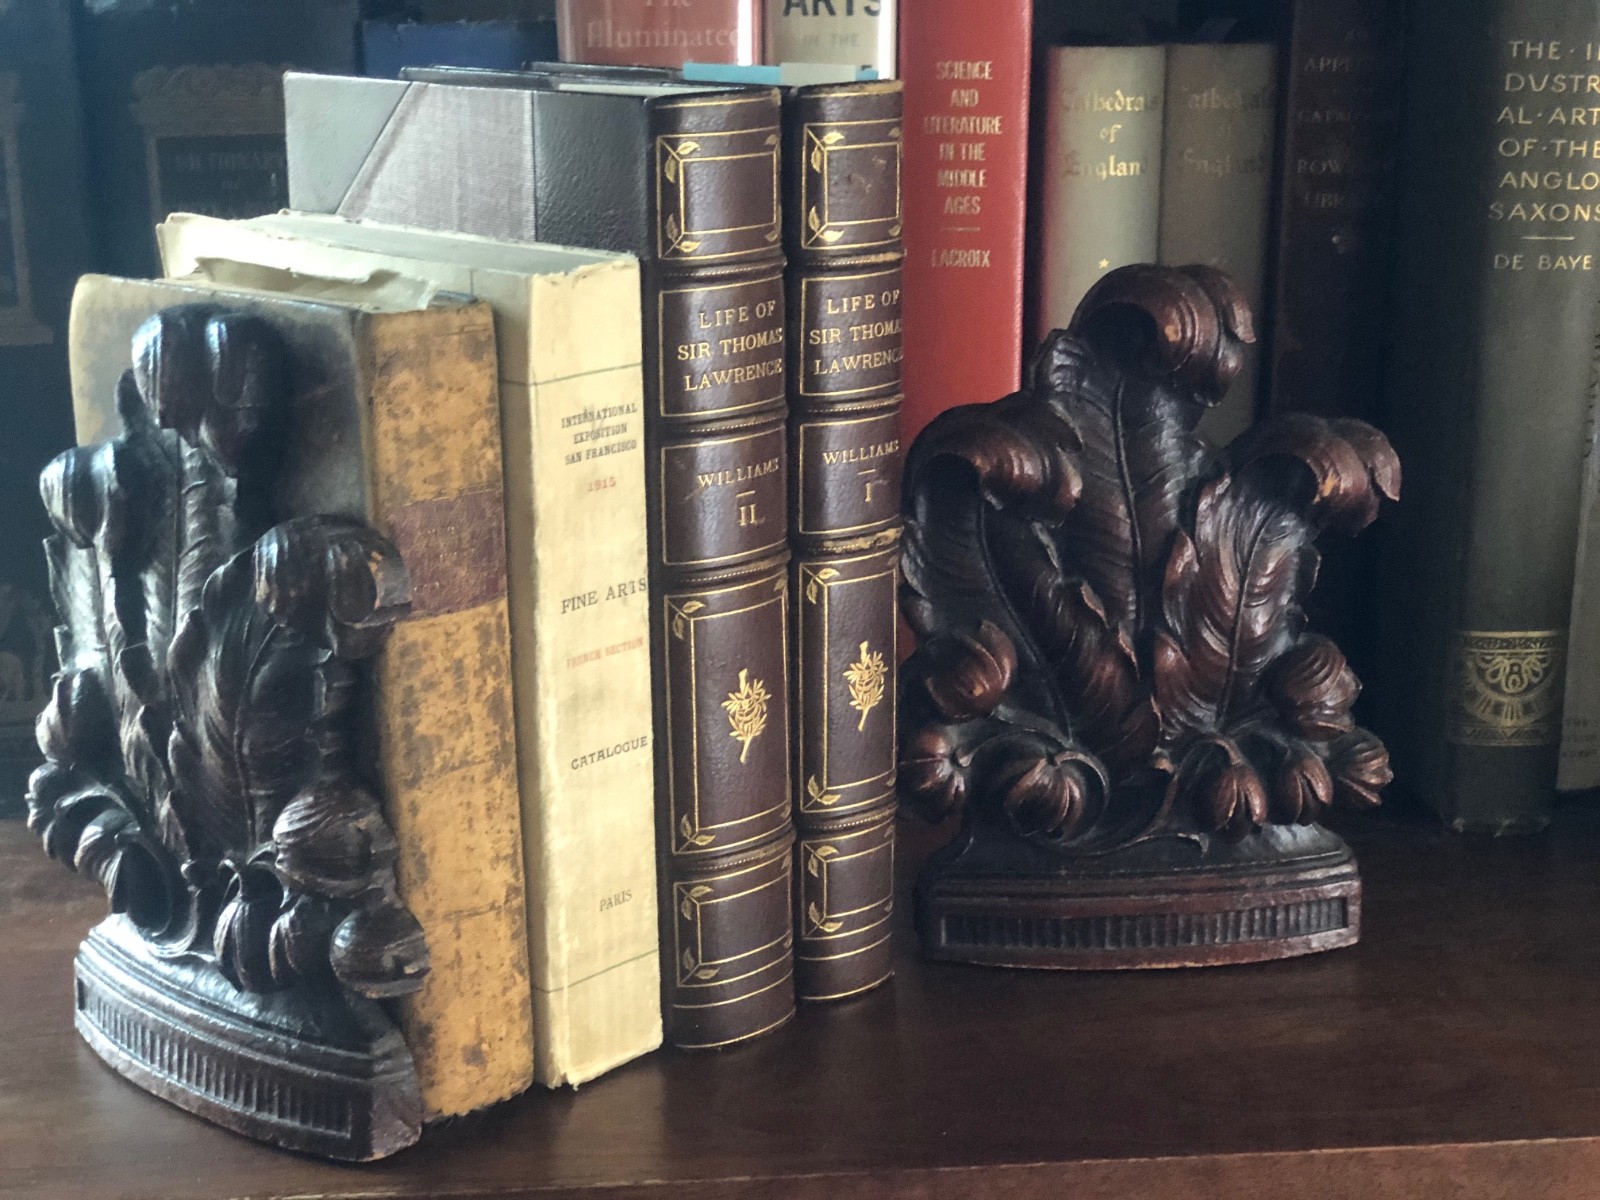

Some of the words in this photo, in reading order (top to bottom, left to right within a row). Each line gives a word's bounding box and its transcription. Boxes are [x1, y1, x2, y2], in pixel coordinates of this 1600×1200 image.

[1509, 41, 1561, 61] THE
[936, 60, 993, 80] SCIENCE
[950, 88, 980, 108] AND
[923, 115, 1003, 135] LITERATURE
[1497, 106, 1533, 126] AL
[1099, 123, 1123, 144] of
[940, 143, 955, 161] IN
[960, 143, 987, 161] THE
[1498, 138, 1538, 158] OF
[1550, 138, 1600, 159] THE
[937, 169, 988, 188] MIDDLE
[944, 196, 982, 215] AGES
[1489, 203, 1600, 222] SAXONS
[931, 250, 991, 268] LACROIX
[1494, 254, 1524, 271] DE
[1538, 254, 1593, 271] BAYE
[827, 293, 876, 315] LIFE
[881, 289, 900, 307] OF
[699, 305, 749, 330] LIFE
[755, 299, 777, 319] OF
[677, 342, 712, 361] SIR
[719, 327, 783, 356] THOMAS
[809, 327, 842, 346] SIR
[684, 357, 783, 391] LAWRENCE
[561, 403, 638, 429] INTERNATIONAL
[573, 422, 628, 445] EXPOSITION
[564, 451, 583, 466] SAN
[586, 439, 637, 461] FRANCISCO
[823, 439, 900, 466] WILLIAMS
[698, 457, 780, 488] WILLIAMS
[587, 476, 617, 493] 1915
[864, 482, 874, 503] I
[737, 503, 759, 527] II
[561, 590, 598, 615] FINE
[605, 577, 647, 601] ARTS
[570, 735, 649, 770] CATALOGUE
[599, 889, 632, 912] PARIS
